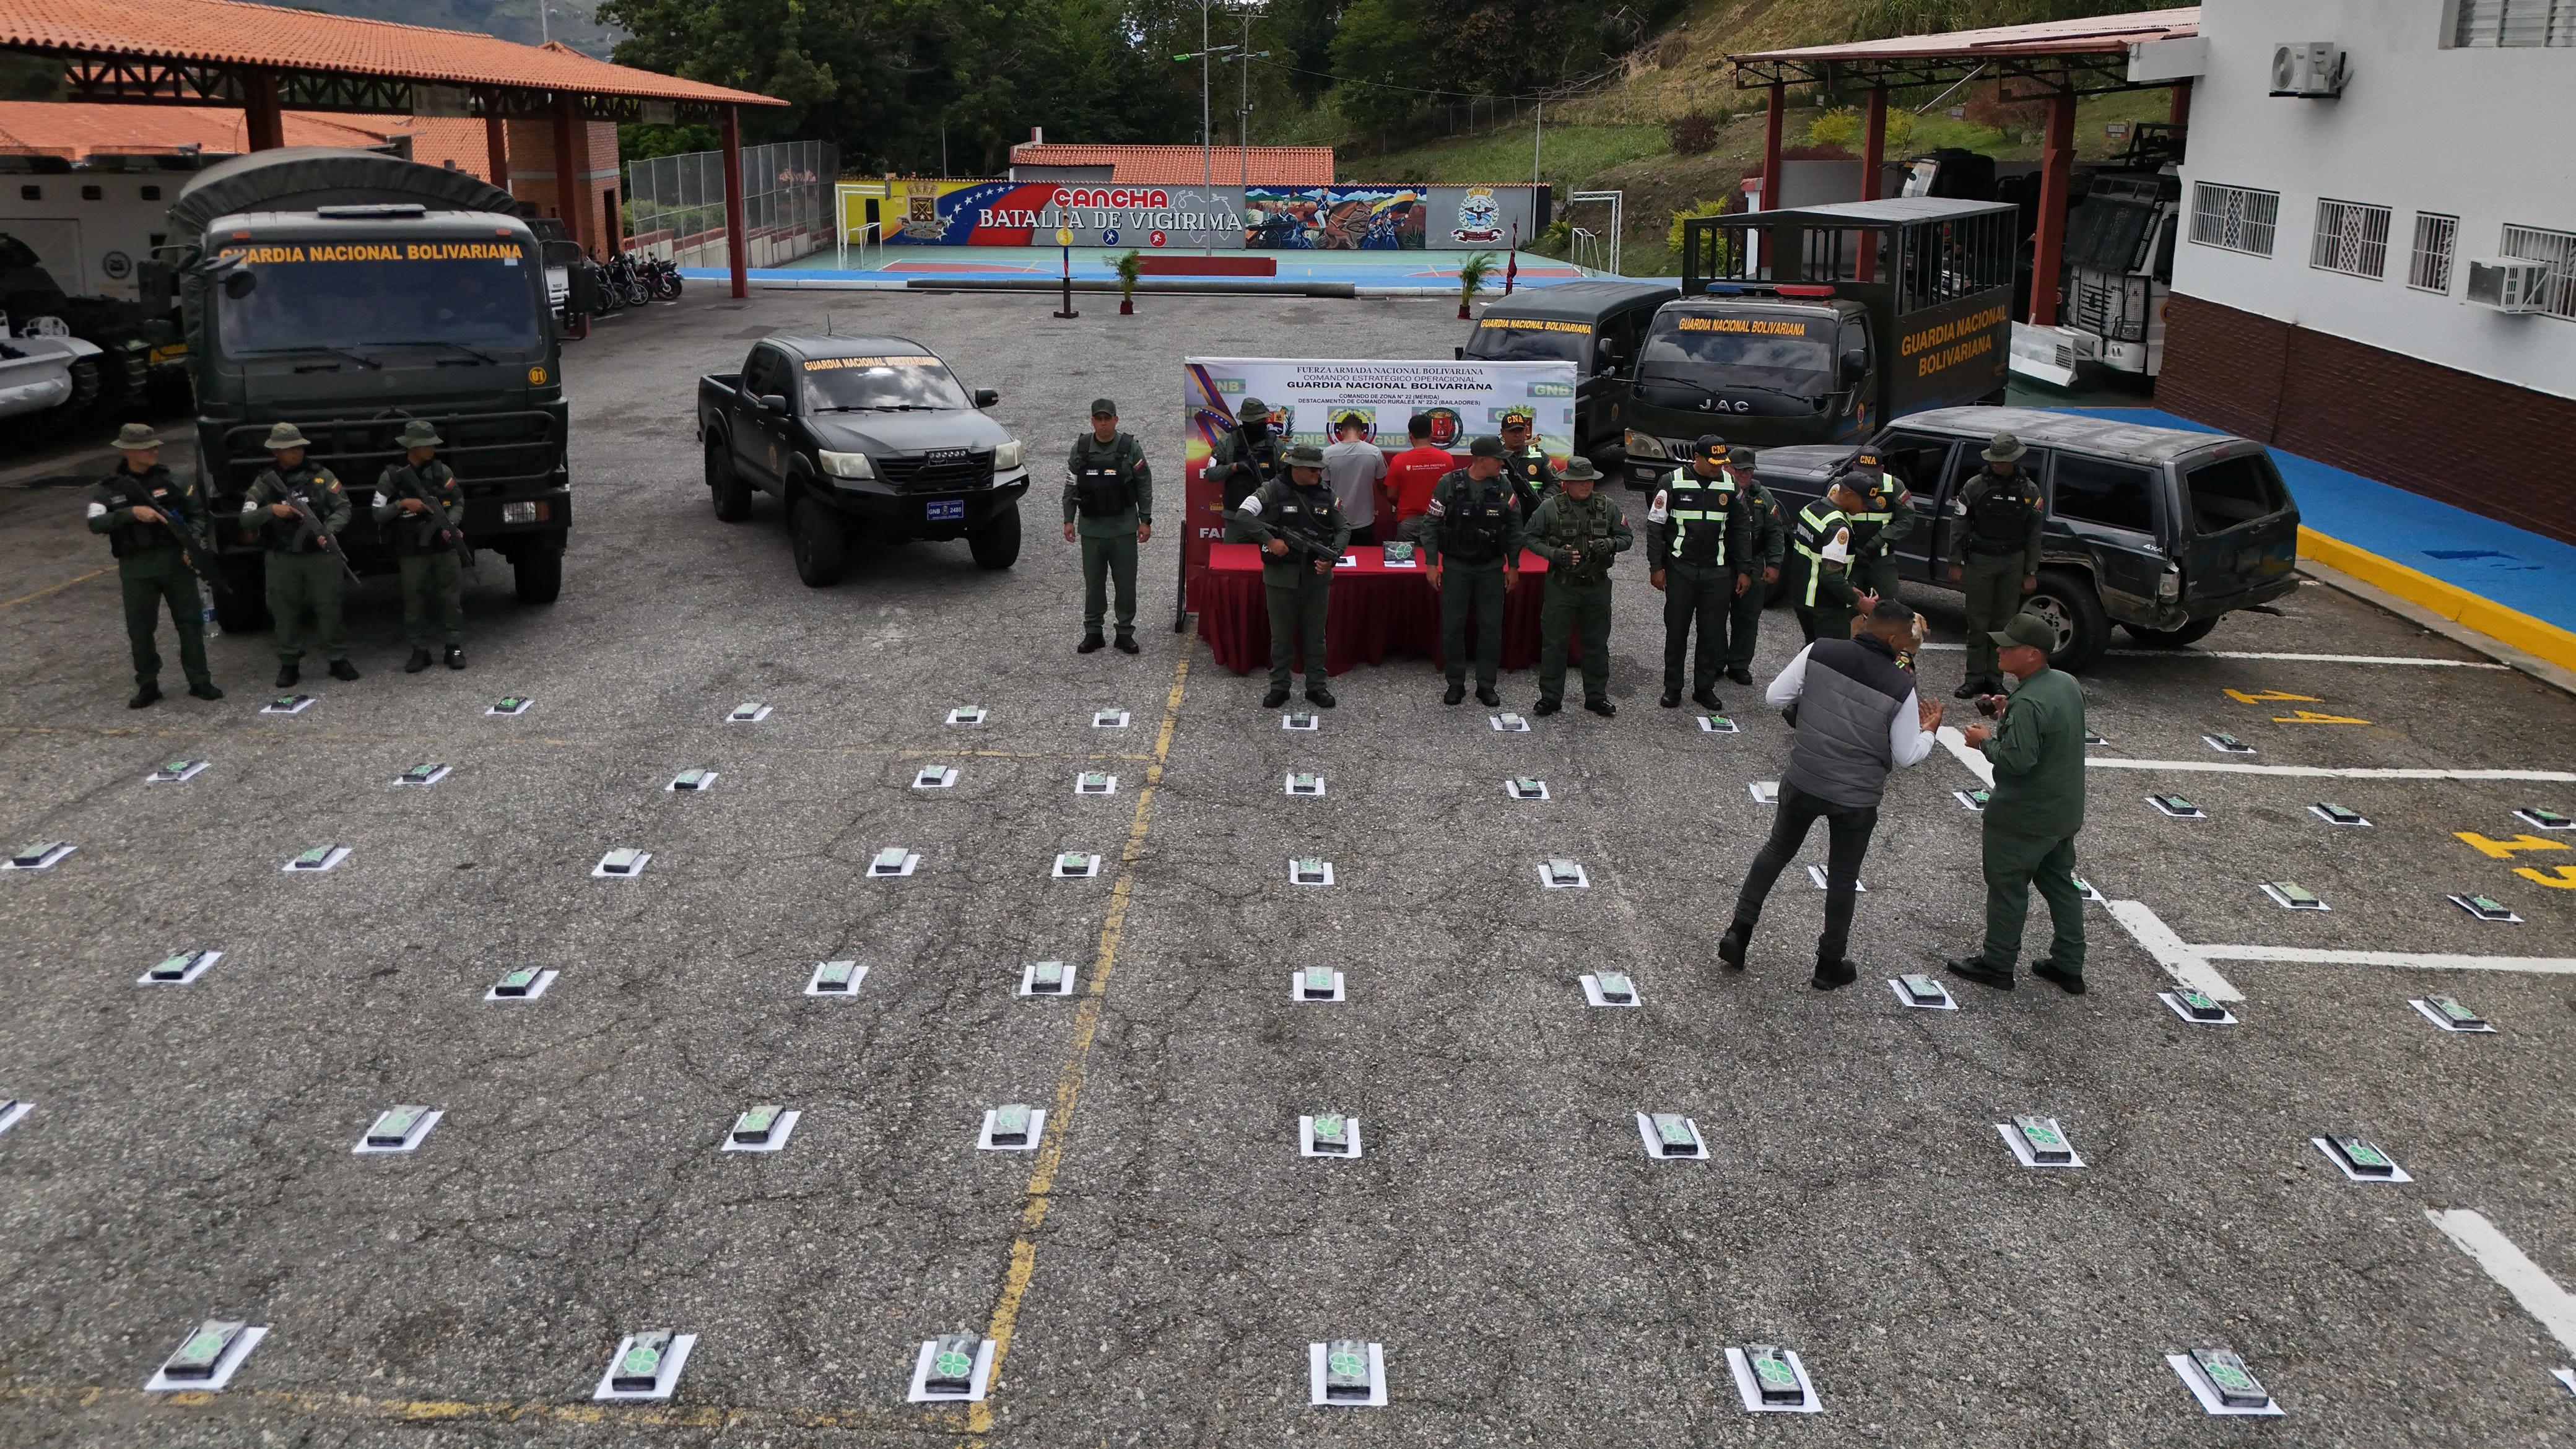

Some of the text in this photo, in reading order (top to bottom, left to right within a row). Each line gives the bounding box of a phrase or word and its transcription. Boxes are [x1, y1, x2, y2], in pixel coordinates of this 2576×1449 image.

[1053, 188, 1168, 209] CANCHA
[979, 209, 1242, 231] BATALLA DE VIGIRIMA
[310, 245, 403, 261] NACIONAL
[407, 244, 523, 260] BOLIVARIANA
[1481, 319, 1591, 334] GUARDIA NACIONAL BOLIVARIANA
[1679, 318, 1805, 336] GUARDIA NACIONAL BOLIVARIANA
[1902, 305, 2007, 356] GUARDIA NACIONAL
[1918, 334, 1992, 376] BOLIVARIANA
[804, 356, 941, 372] GUARDIA NACIONAL BOLIVARIANA
[531, 370, 544, 381] 01
[1214, 381, 1239, 391] NB
[1534, 385, 1569, 396] GNB
[1699, 399, 1749, 412] JAC
[1507, 415, 1524, 424] CNA
[1292, 434, 1325, 445] GNB
[1373, 435, 1406, 446] GNB
[1711, 444, 1726, 454] CNA
[1860, 455, 1876, 464] CNA
